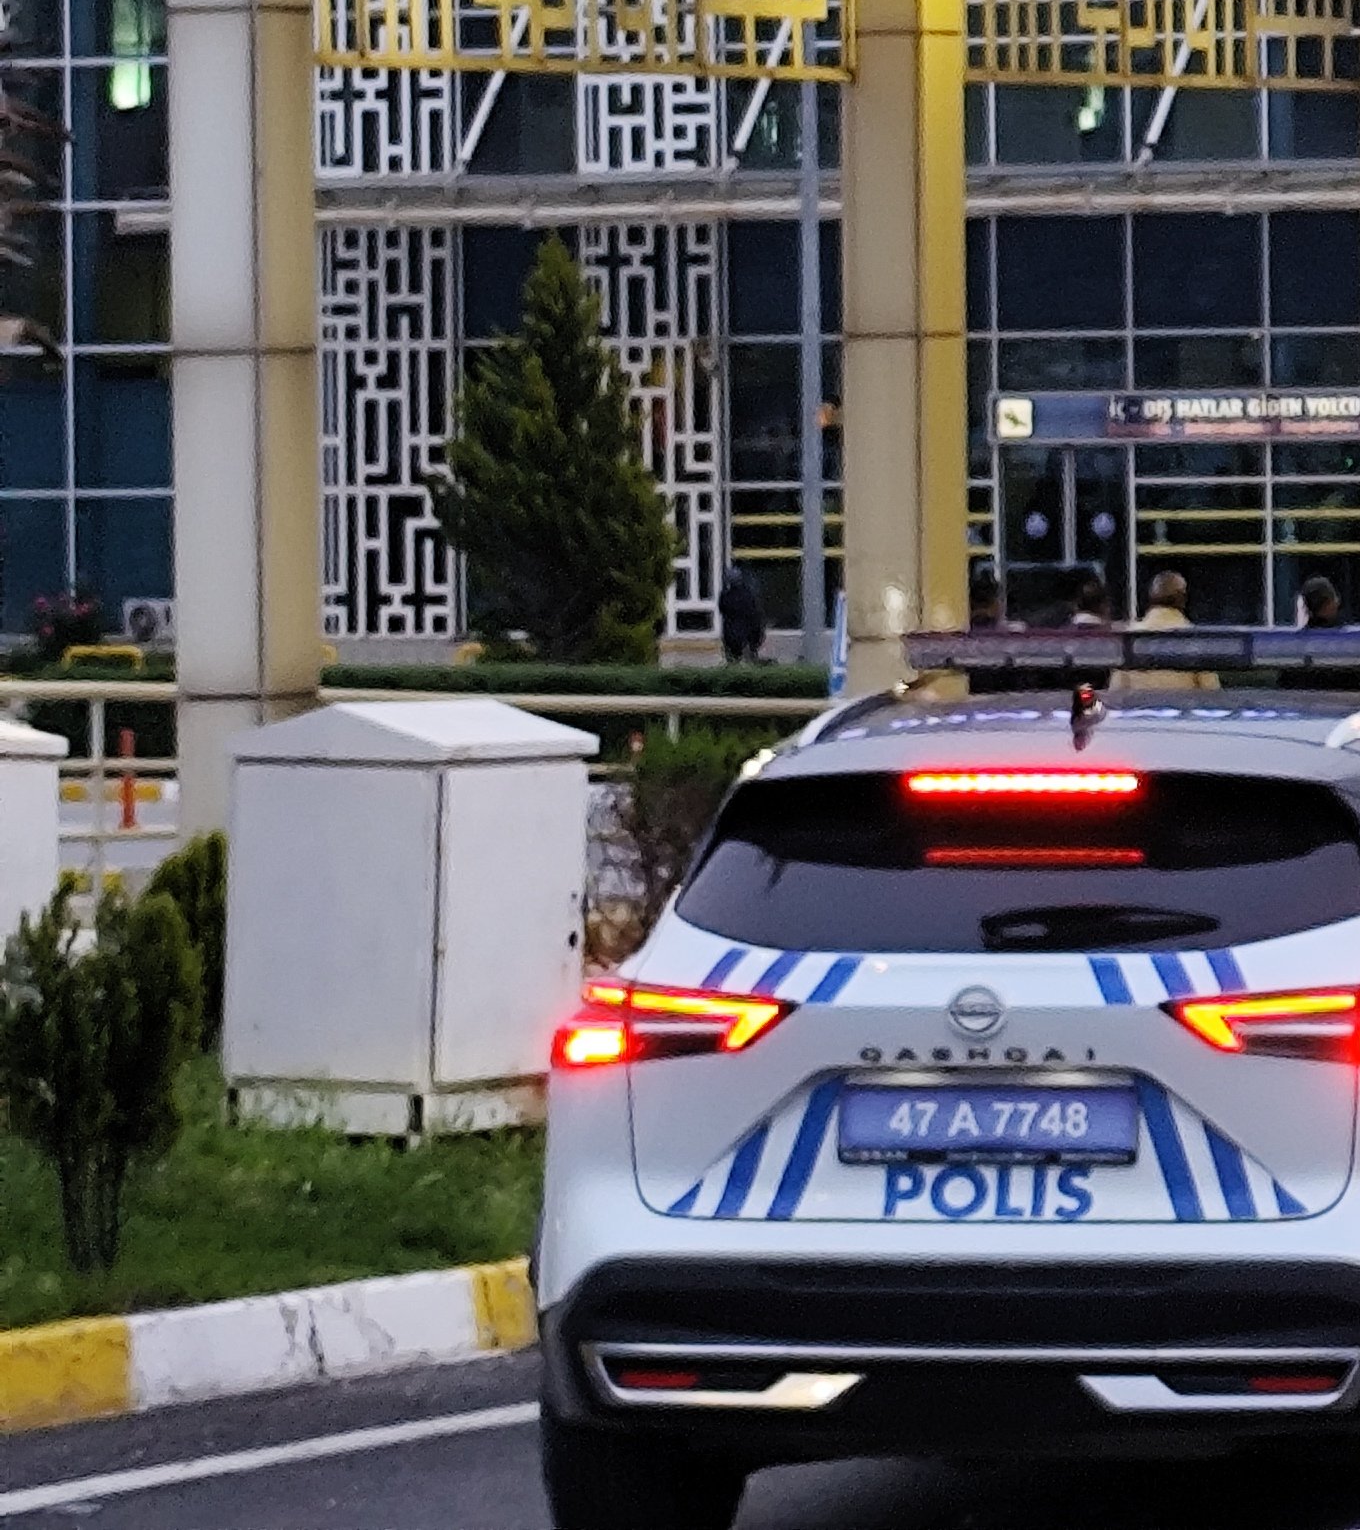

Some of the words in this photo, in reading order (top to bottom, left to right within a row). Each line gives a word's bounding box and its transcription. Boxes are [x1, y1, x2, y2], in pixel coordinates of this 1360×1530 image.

[1176, 396, 1244, 419] HATLAR
[889, 1101, 938, 1138] 47
[948, 1101, 980, 1138] A
[992, 1101, 1089, 1139] 7748
